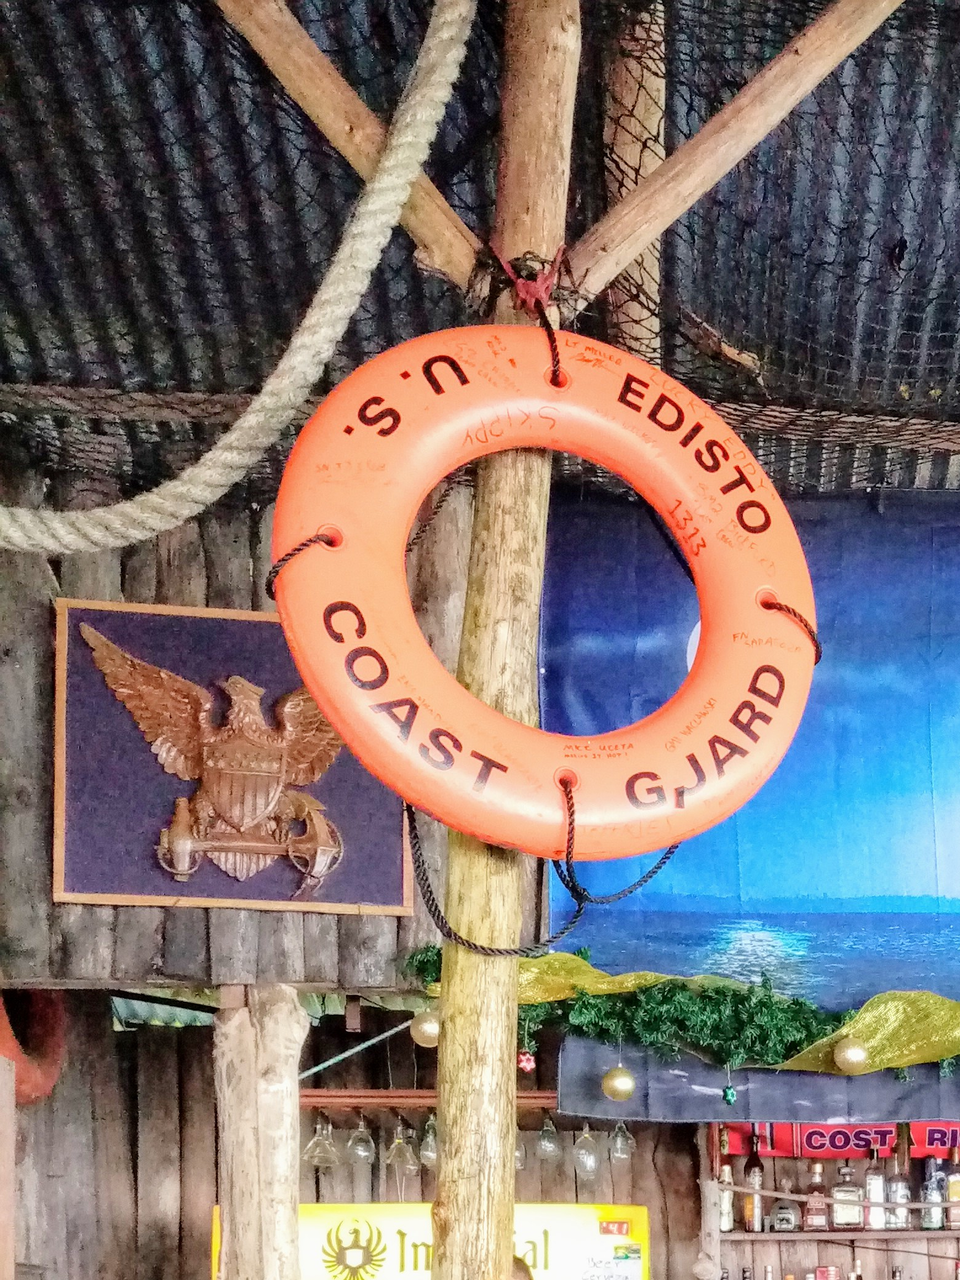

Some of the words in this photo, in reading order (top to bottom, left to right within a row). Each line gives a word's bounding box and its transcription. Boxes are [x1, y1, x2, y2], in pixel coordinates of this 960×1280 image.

[617, 371, 772, 534] EDISTO
[322, 600, 509, 793] COAST
[804, 1127, 917, 1151] COST
